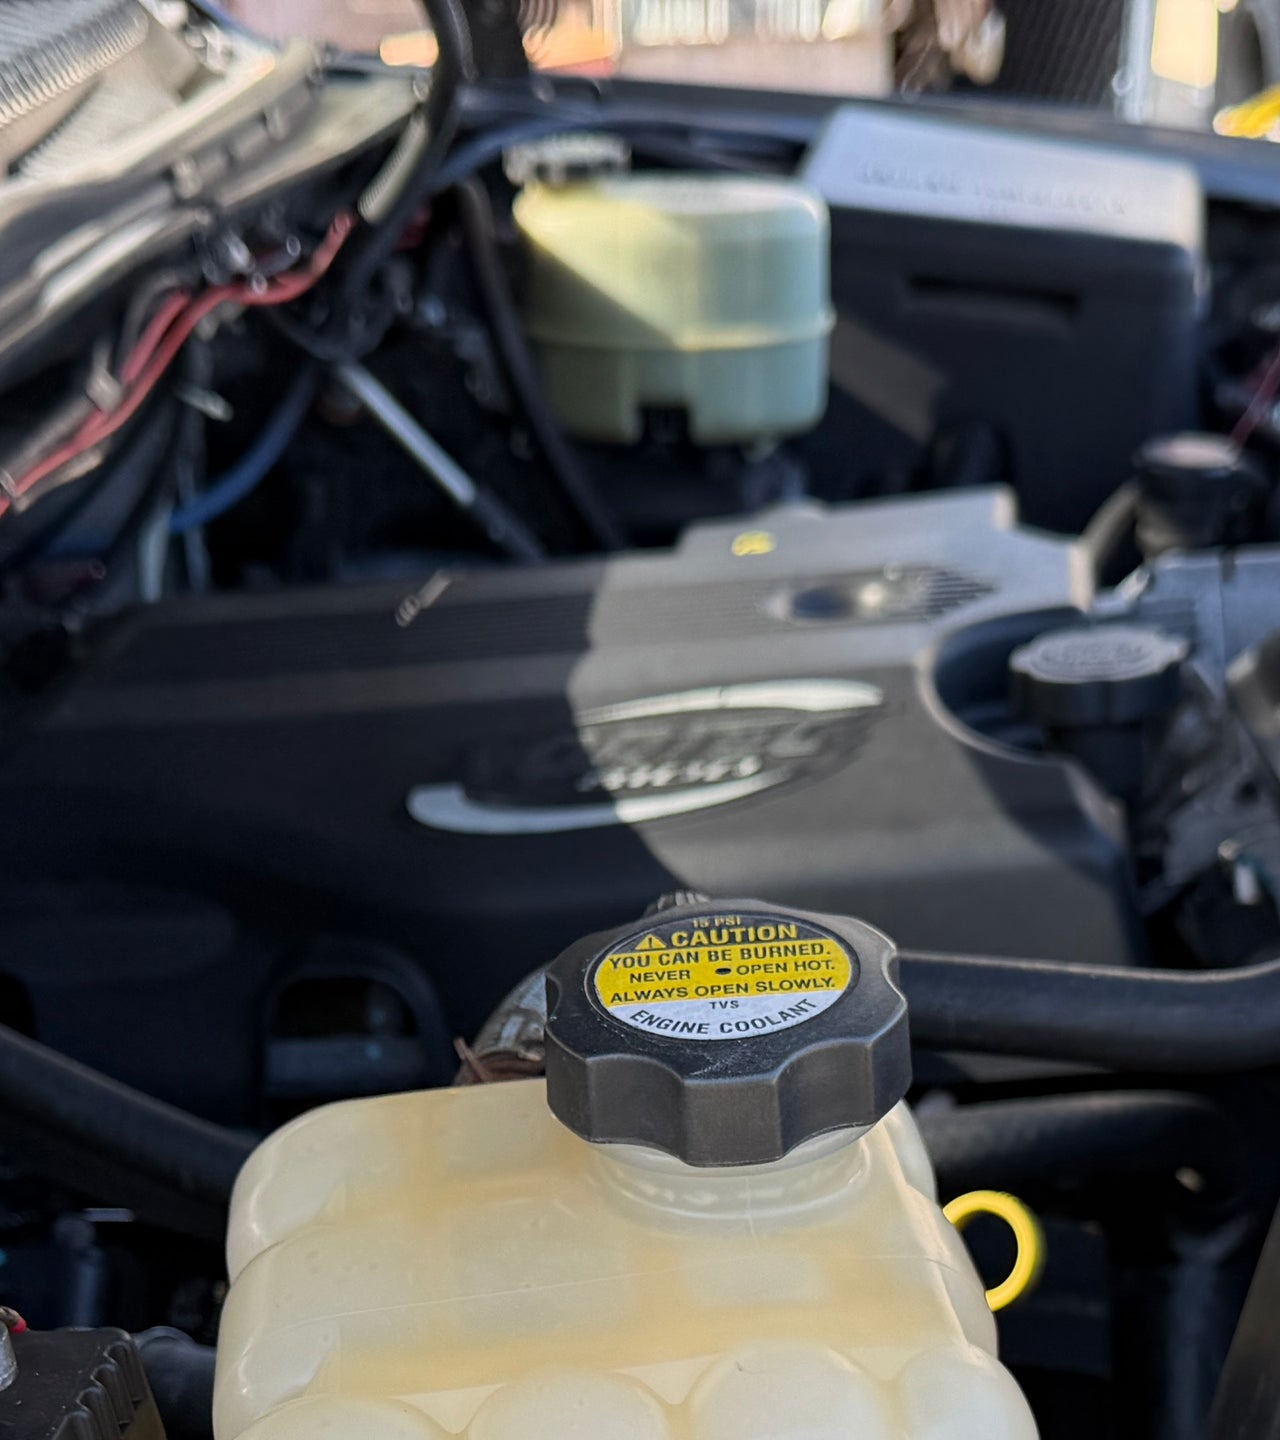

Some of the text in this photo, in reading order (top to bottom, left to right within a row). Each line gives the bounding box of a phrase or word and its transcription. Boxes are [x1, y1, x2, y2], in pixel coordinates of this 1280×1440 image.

[713, 915, 742, 927] PSI
[671, 923, 798, 947] CAUTION
[609, 943, 831, 970] YOU CAN BE BURNED.
[630, 959, 835, 984] NEVER OPEN HOT.
[610, 976, 835, 1004] ALWAYS OPEN SLOWLY.
[630, 998, 818, 1035] ENGINE COOLANT
[709, 1000, 739, 1010] TVS
